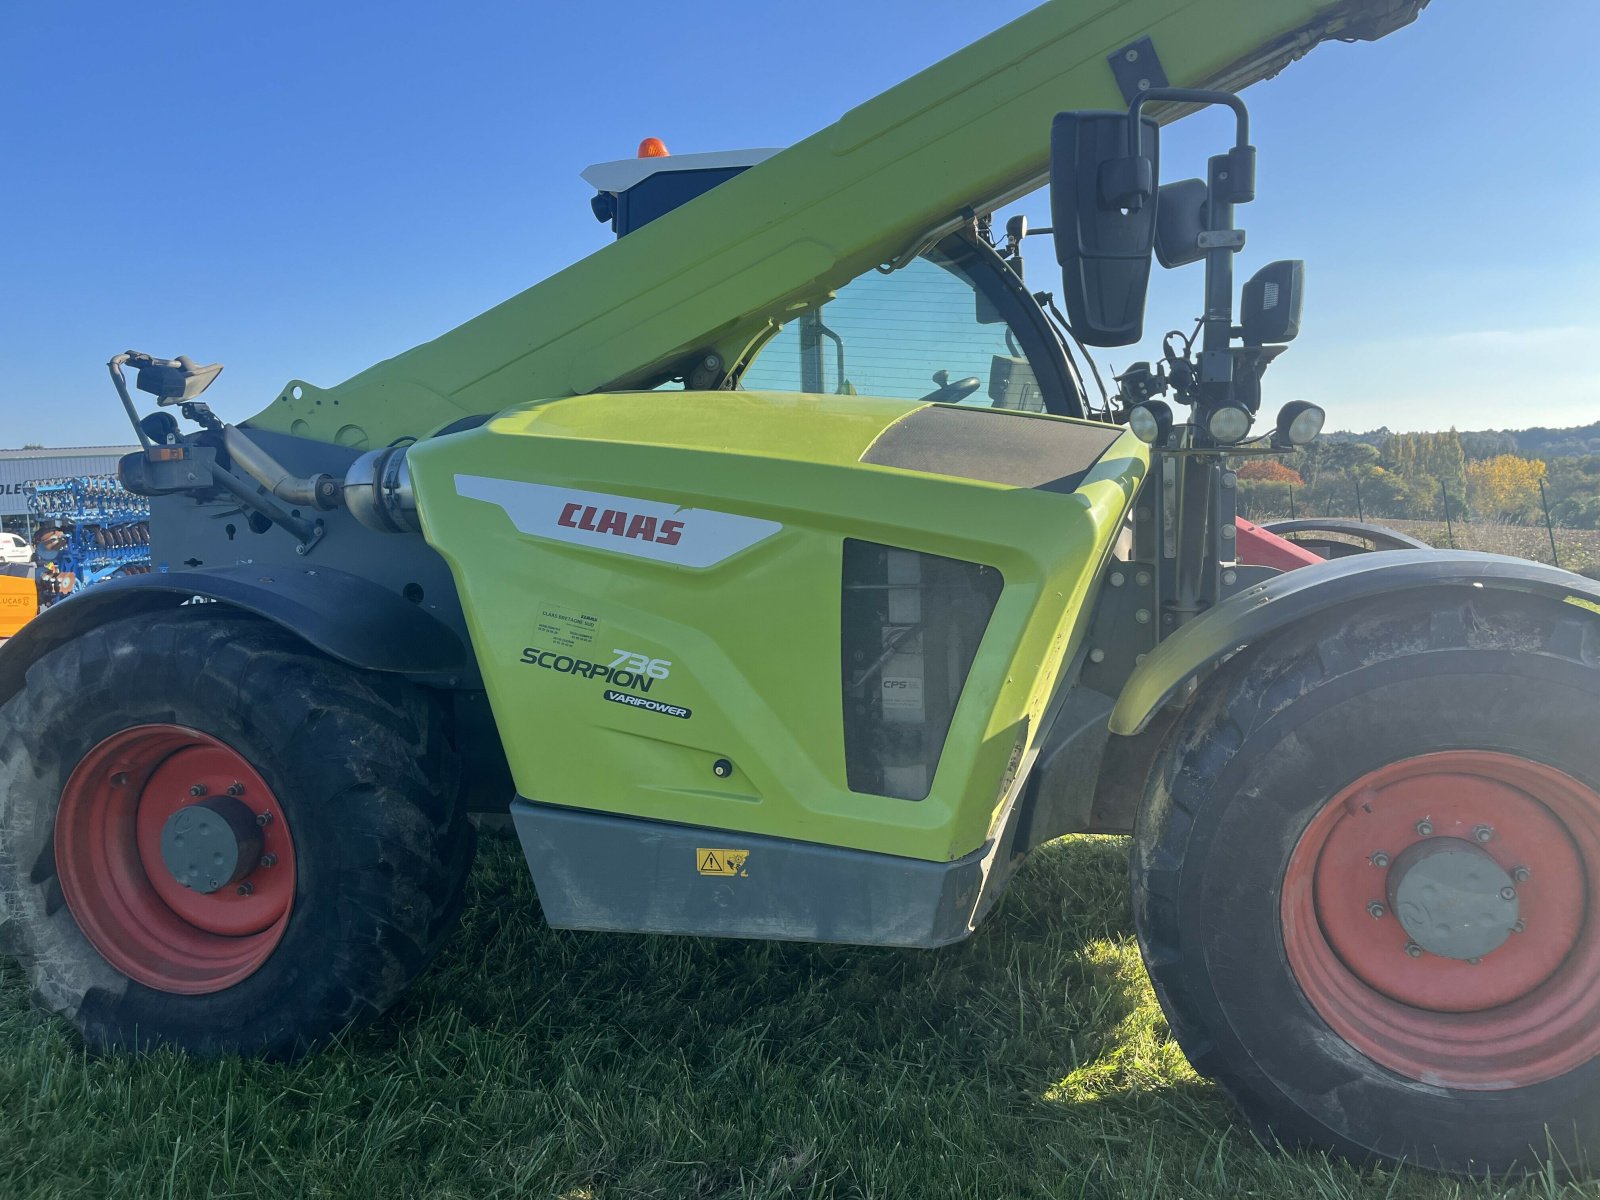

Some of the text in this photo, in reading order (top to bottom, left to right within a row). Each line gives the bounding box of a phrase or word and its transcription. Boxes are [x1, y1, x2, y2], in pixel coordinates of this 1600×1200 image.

[557, 502, 686, 546] CLAAS
[542, 610, 558, 619] CLAAS
[519, 647, 654, 693] SCORPION
[608, 648, 672, 680] 736
[883, 680, 907, 689] CPS
[609, 691, 687, 717] VARIPOWER
